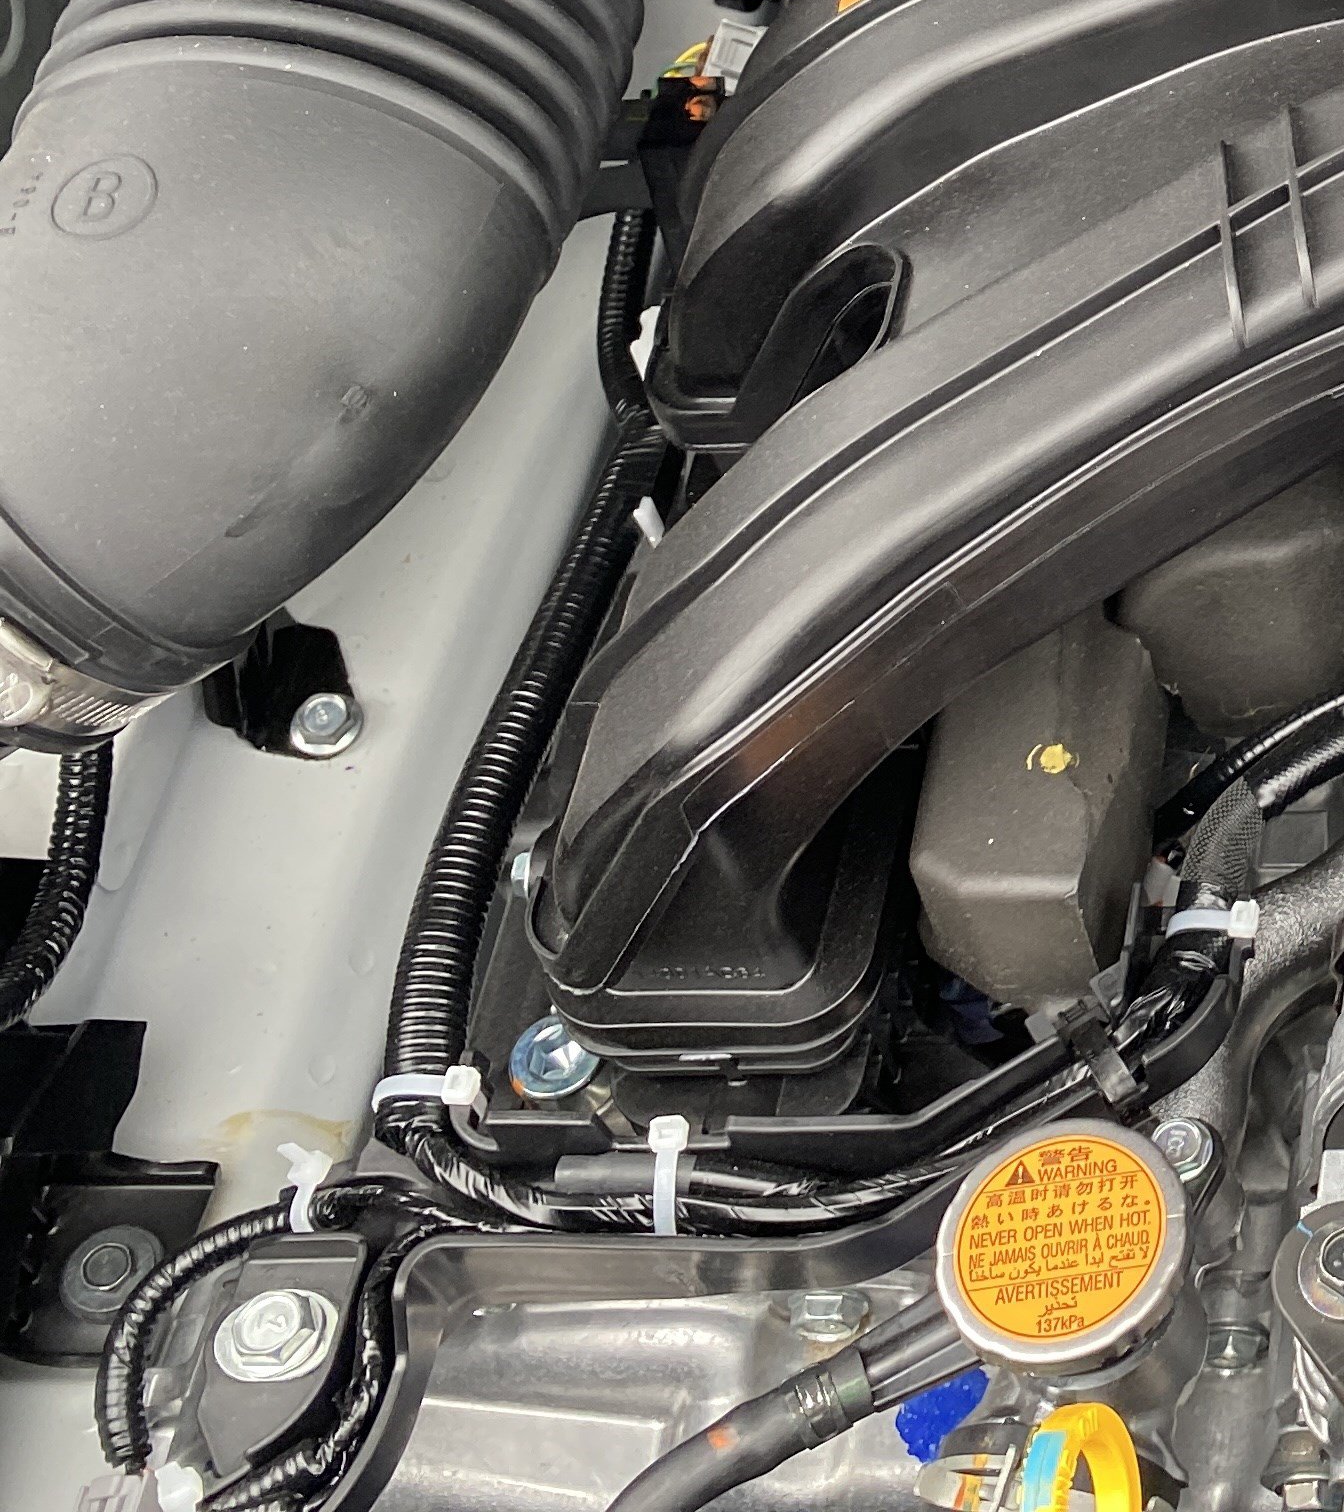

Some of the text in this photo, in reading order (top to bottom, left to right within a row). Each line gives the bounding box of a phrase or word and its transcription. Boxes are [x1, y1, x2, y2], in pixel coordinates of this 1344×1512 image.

[1037, 1145, 1094, 1169] 警告
[1037, 1158, 1118, 1182] WARNING
[985, 1174, 1138, 1209] 高温时请勿打开
[969, 1209, 1152, 1250] NEVER OPEN WHEN HOT.
[968, 1253, 986, 1270] NE
[989, 1245, 1036, 1268] JAMAIS
[1041, 1238, 1088, 1261] OUVRIR
[1092, 1232, 1103, 1251] À
[994, 1271, 1124, 1305] AVERTISSEMENT
[1035, 1315, 1085, 1334] 137kPa
